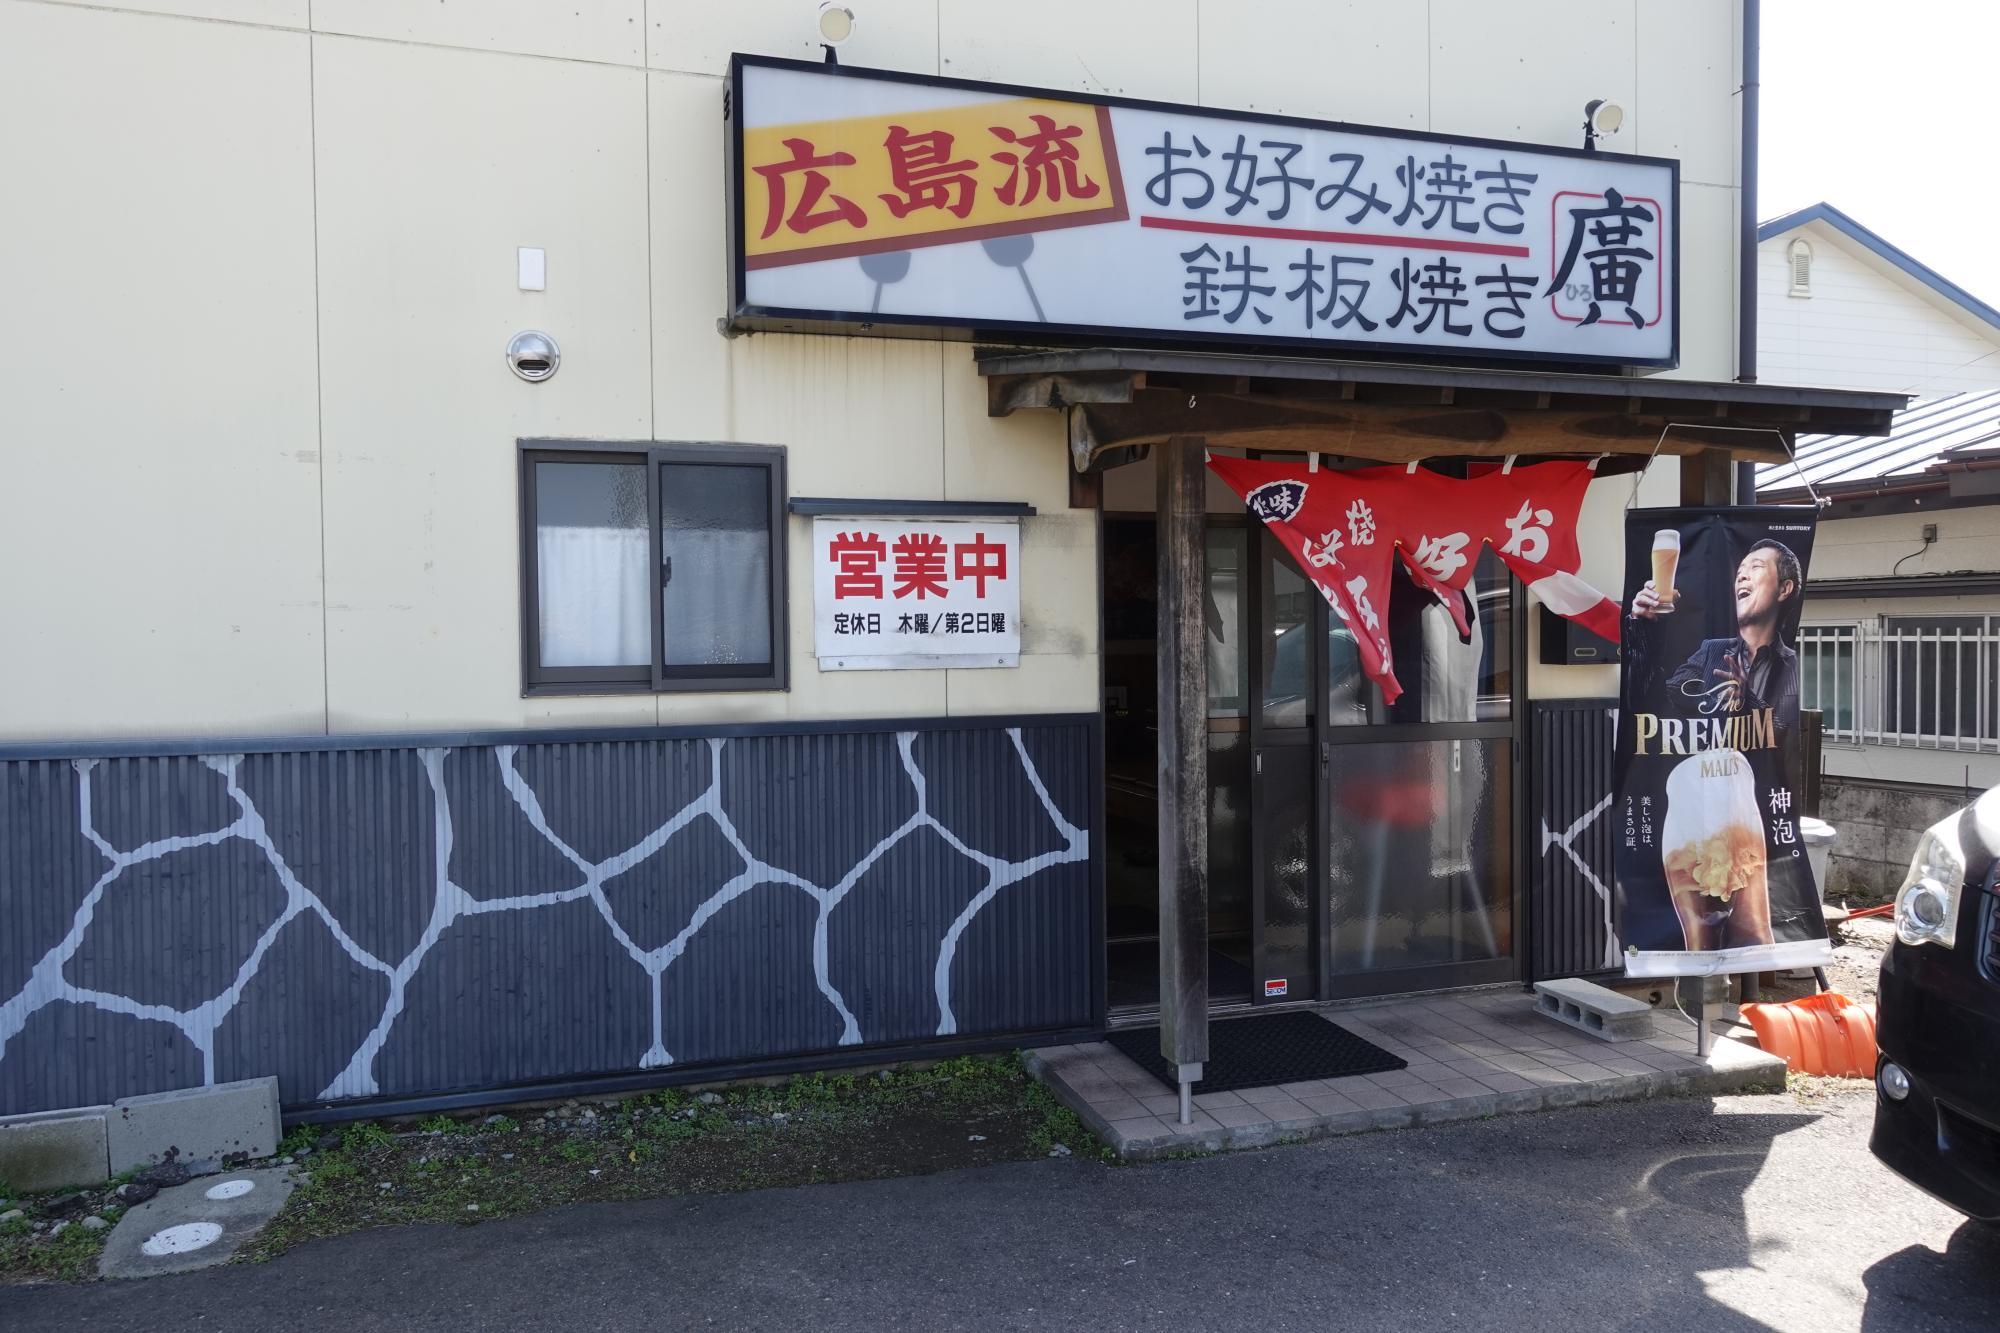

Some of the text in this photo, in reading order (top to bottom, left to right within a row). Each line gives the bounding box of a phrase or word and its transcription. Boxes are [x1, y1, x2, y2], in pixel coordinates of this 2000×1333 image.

[752, 115, 1100, 239] 広島流
[1144, 130, 1538, 234] お好み焼き
[1179, 243, 1539, 338] 鉄板焼き
[1565, 283, 1592, 301] ひろ
[829, 531, 1007, 600] 営業中
[834, 613, 881, 635] 定休日
[1681, 678, 1745, 714] The
[1634, 708, 1777, 755] PREMIUM
